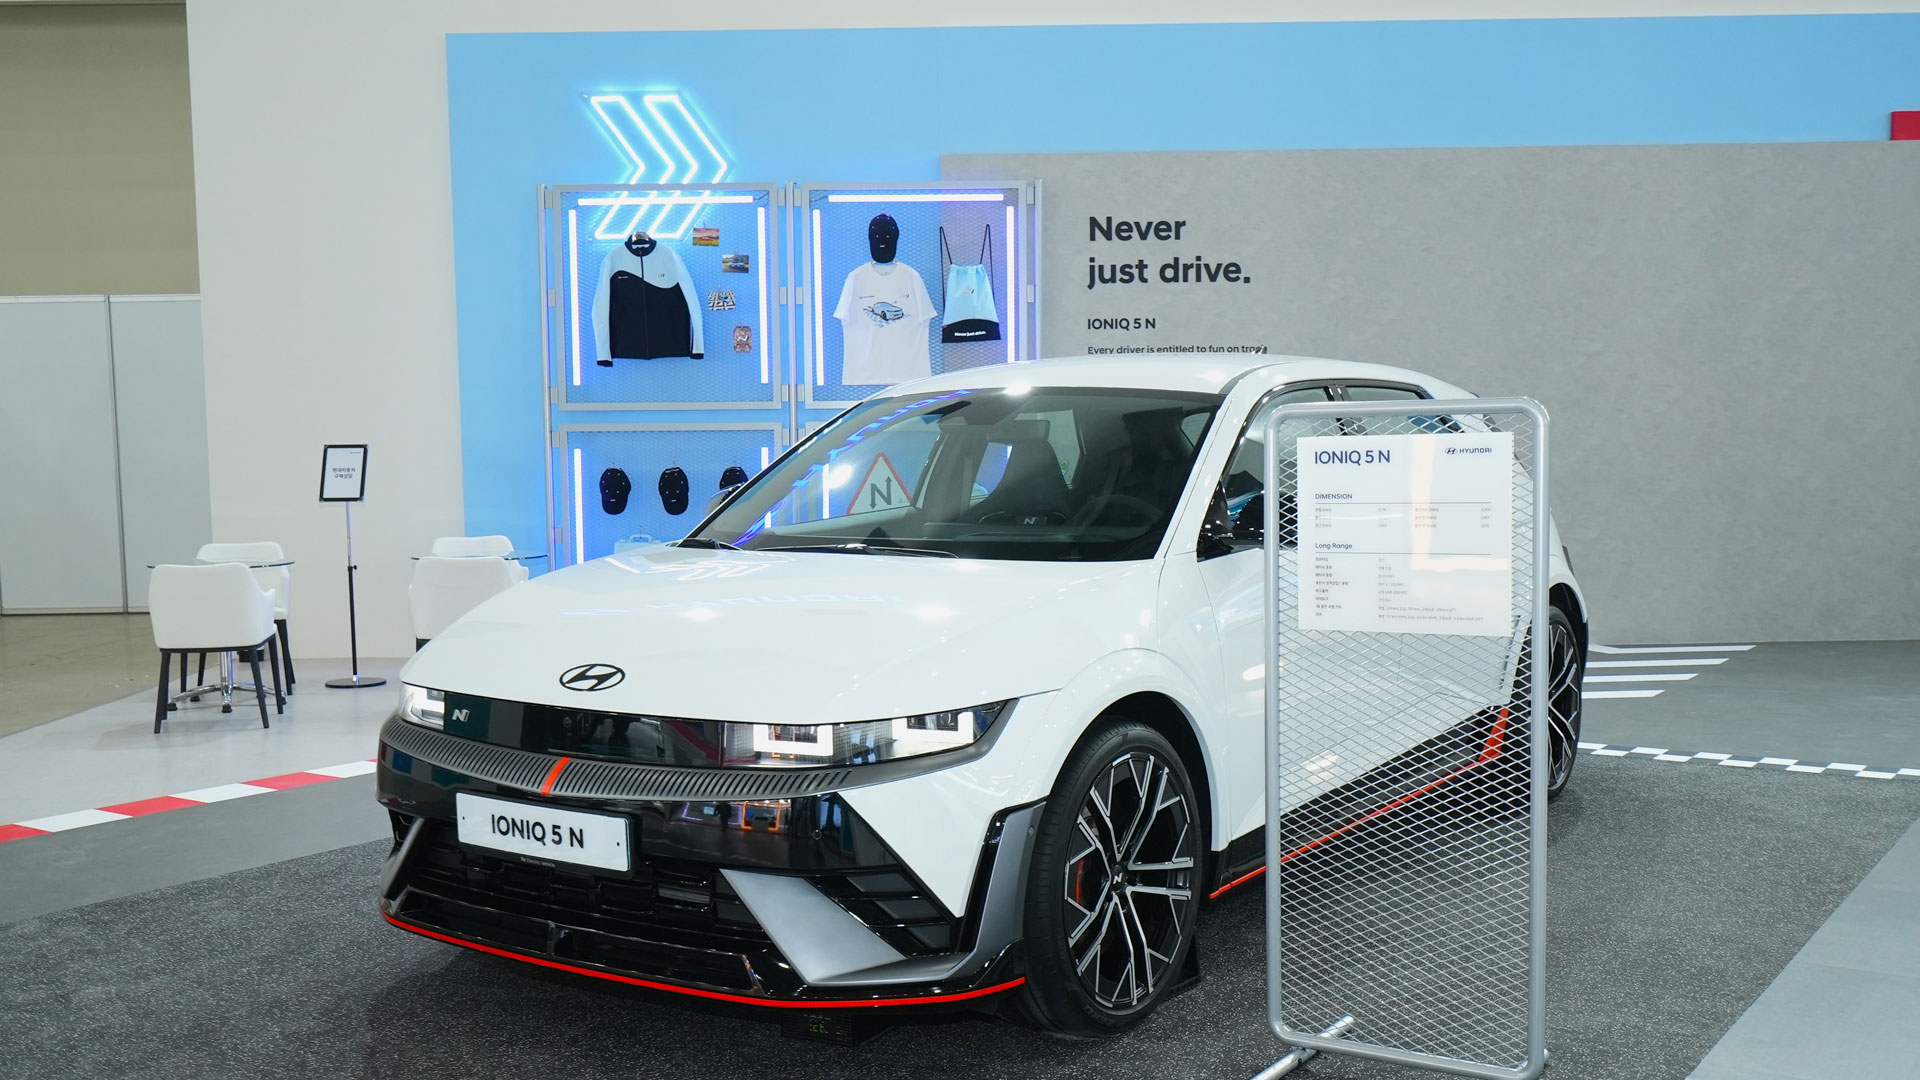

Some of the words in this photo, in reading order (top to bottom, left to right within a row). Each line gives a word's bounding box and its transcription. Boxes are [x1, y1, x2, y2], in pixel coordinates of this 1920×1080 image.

[1089, 216, 1187, 242] Never
[1087, 256, 1149, 290] just
[1159, 255, 1251, 284] drive.
[1087, 318, 1130, 331] IONIQ
[1133, 318, 1142, 330] 5
[1145, 318, 1156, 329] N
[1087, 346, 1115, 355] Every
[1116, 345, 1145, 354] driver
[1146, 345, 1155, 354] is
[1156, 345, 1195, 354] entitled
[1196, 345, 1207, 353] to
[1208, 344, 1225, 353] fun
[1314, 450, 1361, 466] IONIQ
[1364, 449, 1375, 464] 5
[1378, 449, 1391, 464] N
[1314, 542, 1331, 550] Long
[1332, 542, 1353, 550] Range
[491, 813, 547, 847] IONIQ
[551, 824, 563, 846] 5
[569, 826, 584, 849] N
